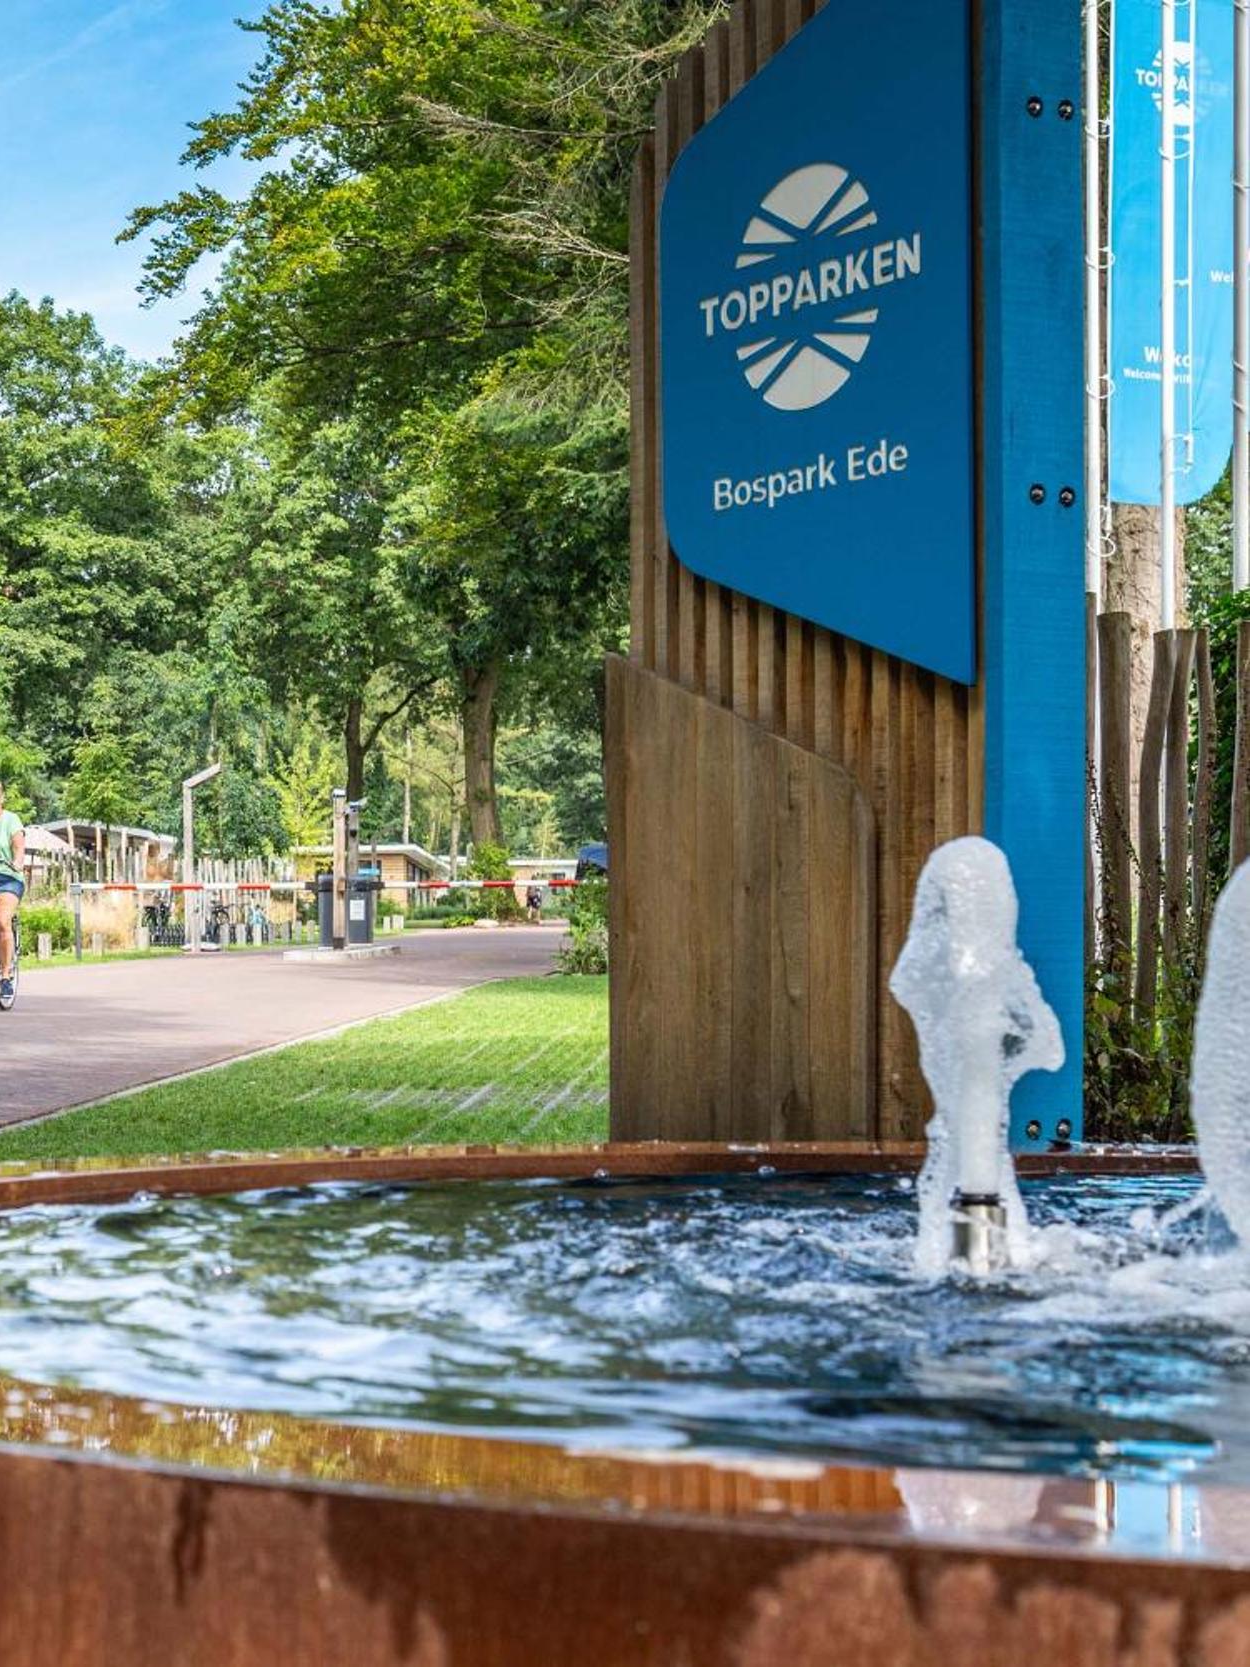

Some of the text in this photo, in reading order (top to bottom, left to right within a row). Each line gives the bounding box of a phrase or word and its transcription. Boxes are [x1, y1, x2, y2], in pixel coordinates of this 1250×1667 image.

[700, 232, 921, 337] TOPPARKEN
[714, 439, 909, 511] Bospark Ede
